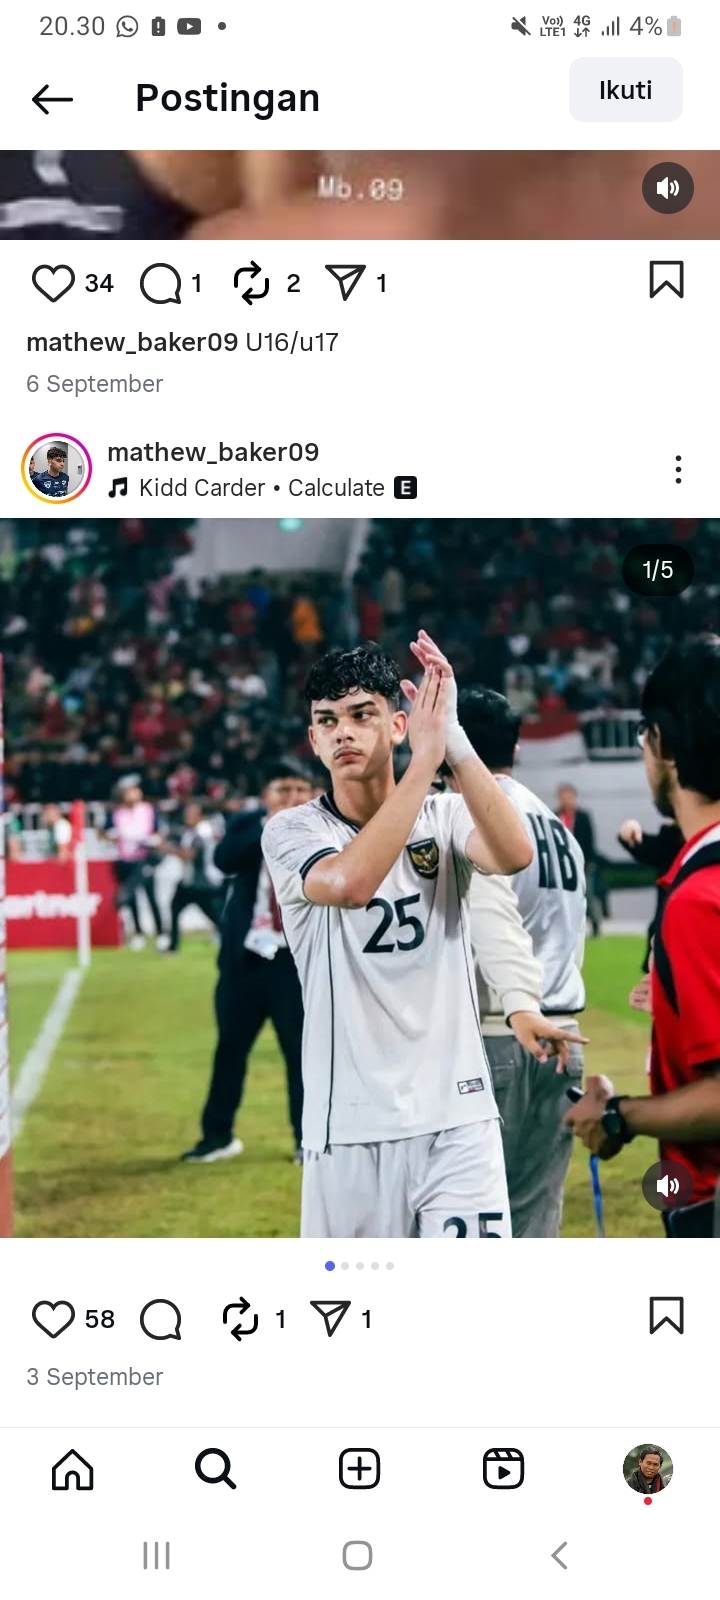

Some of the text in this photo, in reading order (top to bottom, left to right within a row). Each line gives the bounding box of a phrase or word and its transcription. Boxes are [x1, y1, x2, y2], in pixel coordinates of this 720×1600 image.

[39, 15, 105, 36] 20.30
[573, 15, 591, 26] 4G
[629, 15, 663, 36] 4%
[539, 27, 566, 37] LTE1
[600, 79, 652, 101] Ikuti
[136, 81, 319, 121] Postingan
[84, 273, 115, 293] 34
[191, 273, 201, 293] 1
[286, 273, 301, 293] 2
[376, 273, 386, 293] 1
[27, 330, 339, 355] mathew_baker09 U16/u17
[26, 373, 164, 398] 6 September
[108, 441, 319, 465] mathew_baker09
[140, 477, 385, 497] Kidd Carder Calculate
[642, 558, 674, 582] 1/5
[362, 892, 425, 953] 25
[85, 1309, 115, 1329] 58
[275, 1309, 285, 1329] 1
[361, 1309, 371, 1329] 1
[26, 1366, 164, 1391] 3 September
